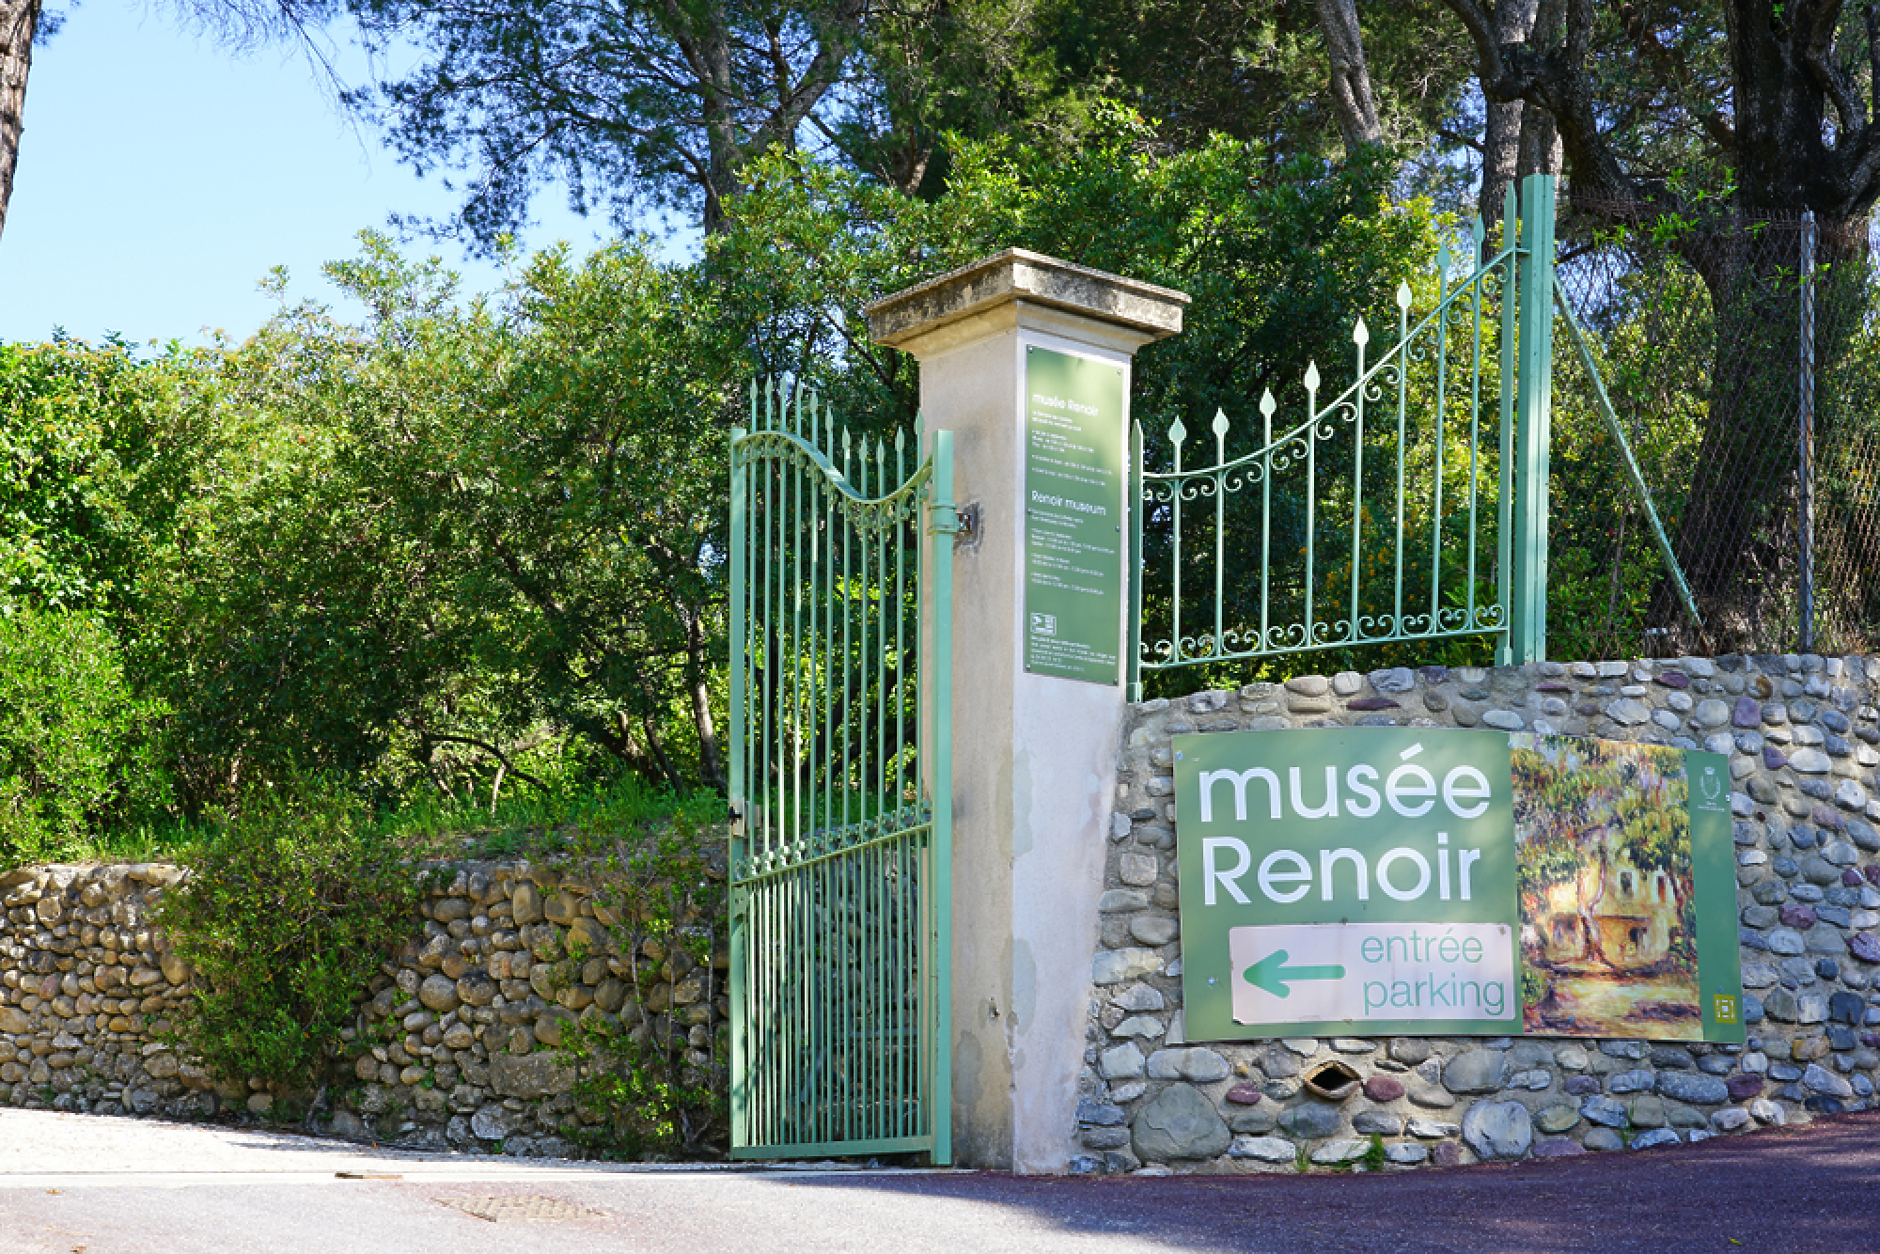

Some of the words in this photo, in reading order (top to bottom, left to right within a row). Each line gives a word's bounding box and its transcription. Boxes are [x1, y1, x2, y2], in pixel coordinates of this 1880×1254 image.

[1032, 393, 1066, 410] musée
[1067, 399, 1099, 416] Renoir
[1031, 490, 1063, 507] Renoir
[1065, 499, 1106, 516] museum
[1199, 742, 1491, 822] musée
[1203, 832, 1481, 905] Renoir
[1361, 928, 1484, 963] entrée
[1363, 973, 1506, 1016] parking
